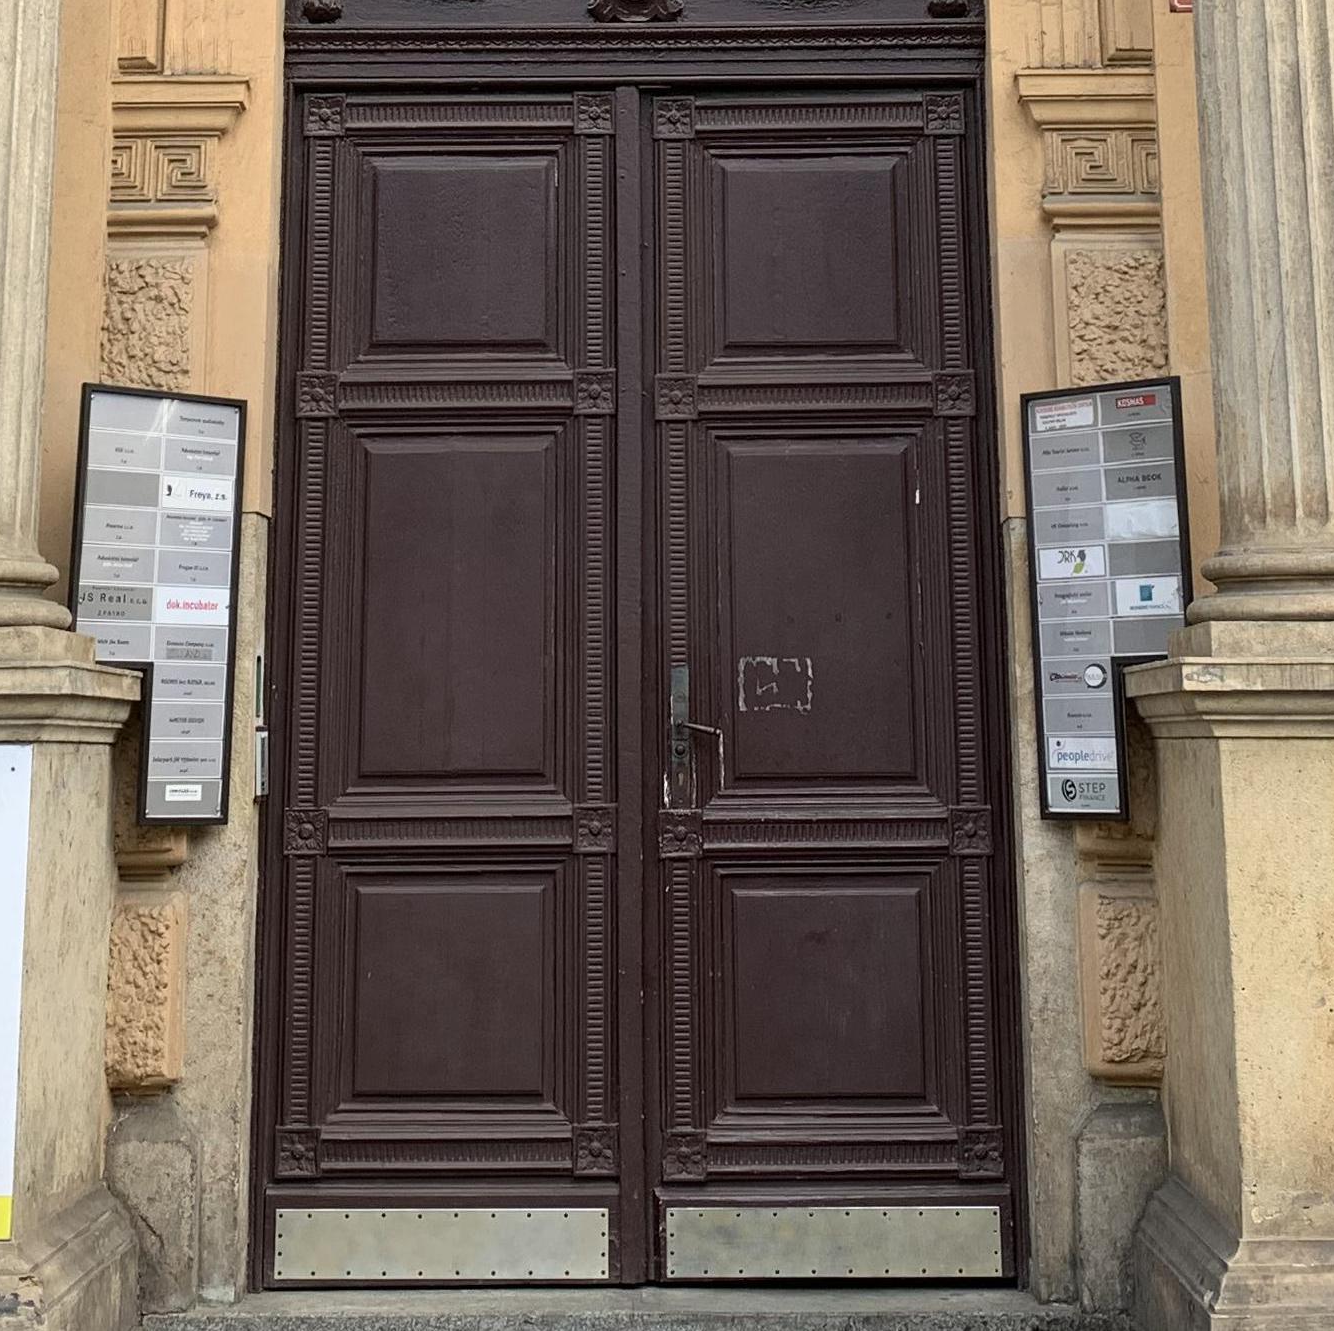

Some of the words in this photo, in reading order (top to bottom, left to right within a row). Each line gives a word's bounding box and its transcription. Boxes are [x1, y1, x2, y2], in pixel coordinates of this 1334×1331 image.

[100, 593, 127, 604] Real
[166, 599, 219, 610] dok.incubator
[1078, 782, 1107, 794] STEP
